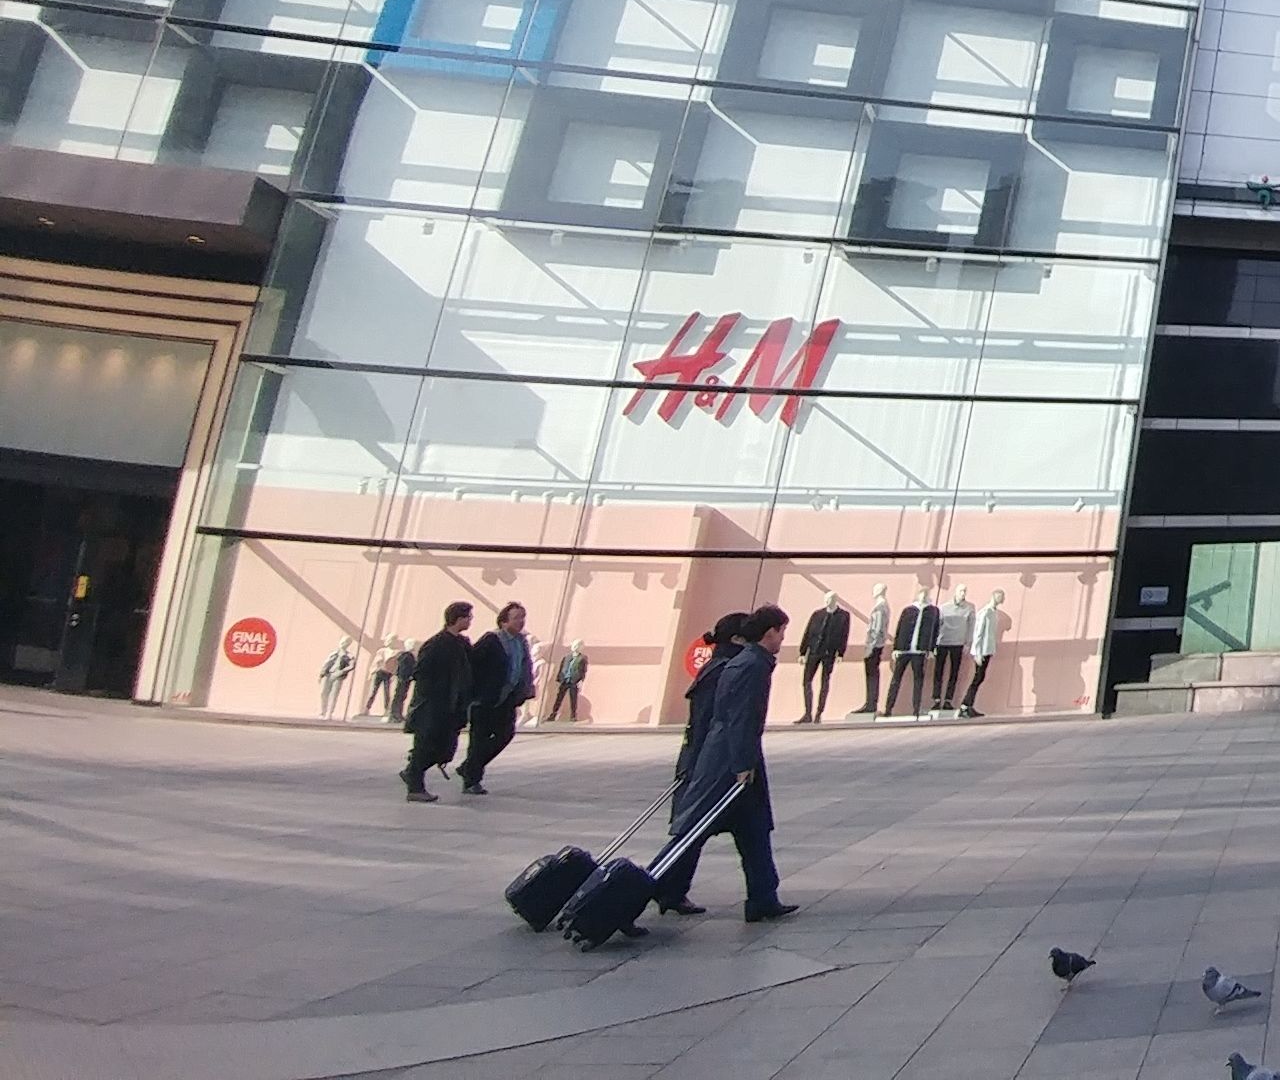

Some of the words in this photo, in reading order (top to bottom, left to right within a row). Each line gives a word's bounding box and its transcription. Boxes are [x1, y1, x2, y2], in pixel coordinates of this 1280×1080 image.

[622, 310, 841, 428] H&M
[232, 631, 269, 644] FINAL
[232, 642, 266, 655] SALE
